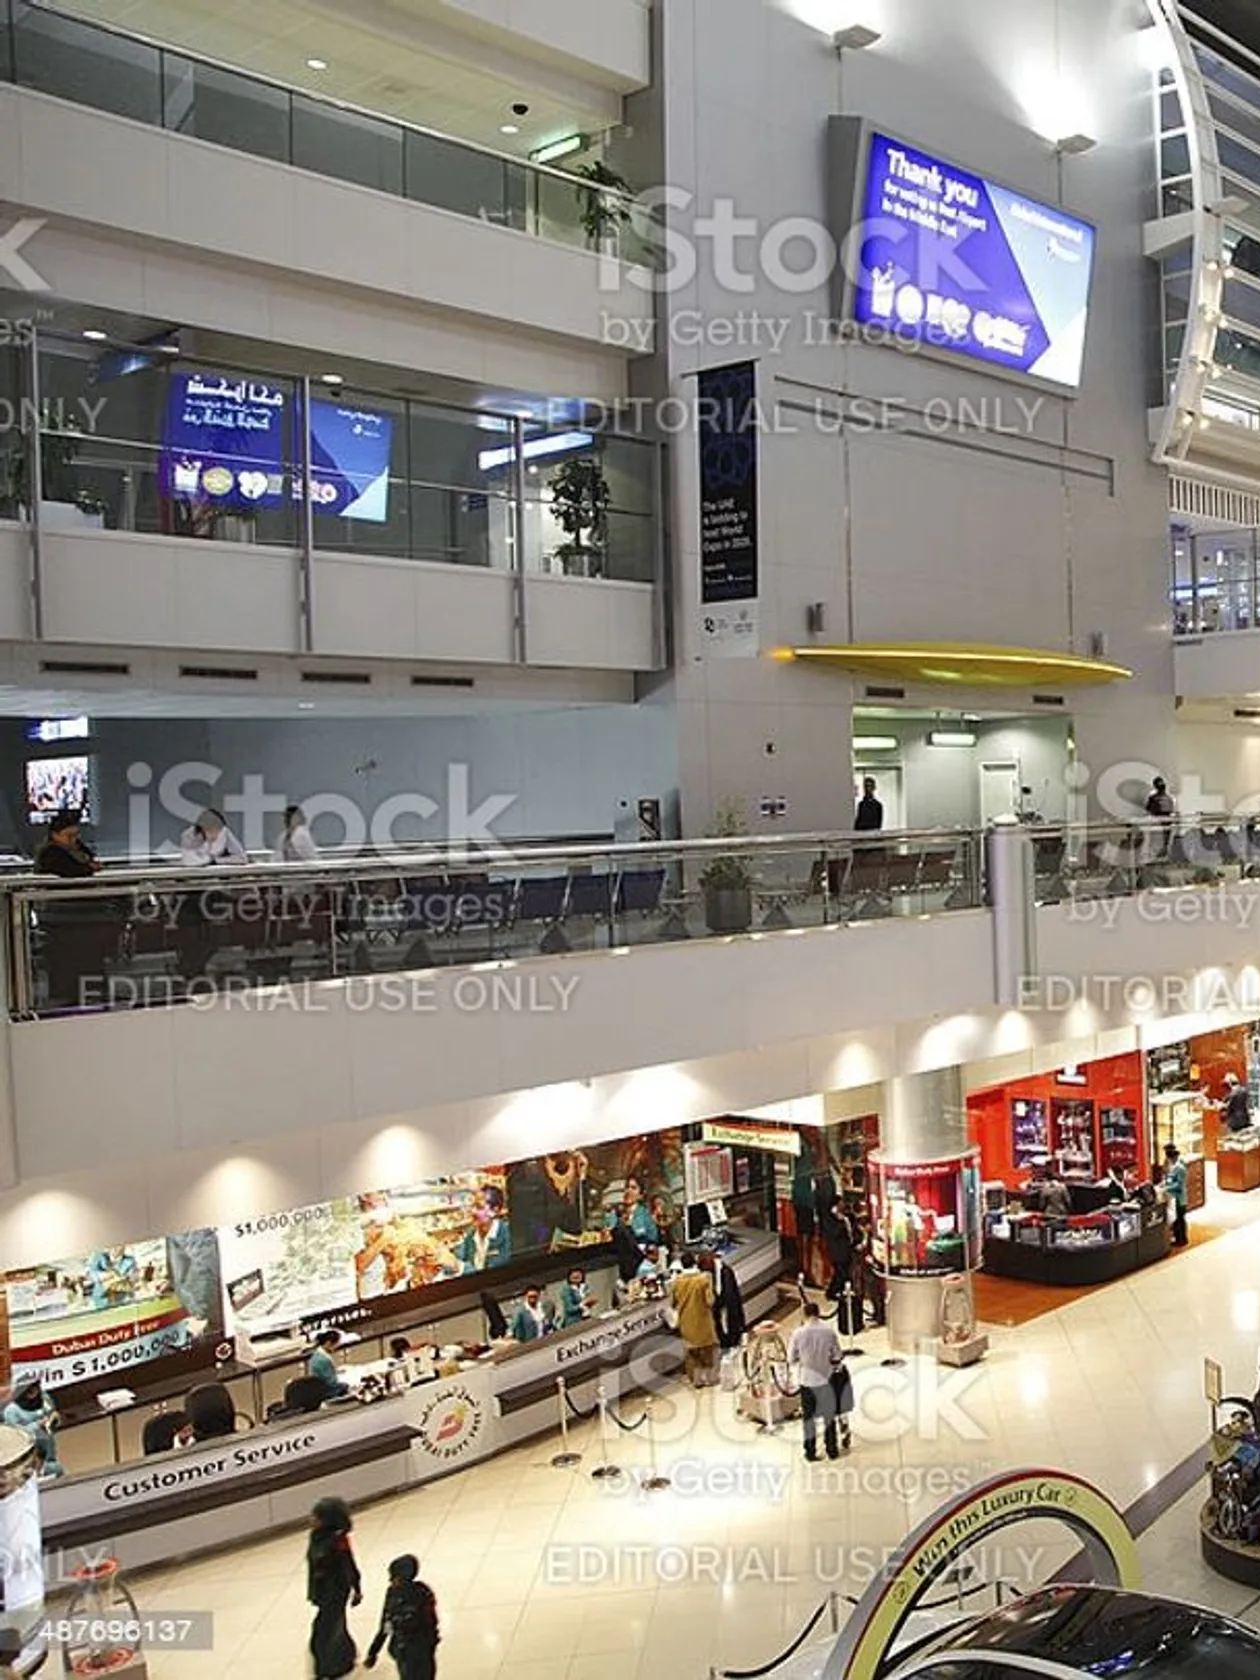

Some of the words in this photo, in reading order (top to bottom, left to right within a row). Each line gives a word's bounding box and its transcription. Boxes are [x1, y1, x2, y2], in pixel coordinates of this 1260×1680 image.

[887, 148, 943, 193] Thank
[943, 178, 979, 208] you
[52, 1339, 97, 1356] Dubai
[556, 1328, 622, 1363] Exchange
[103, 1457, 227, 1500] Customer
[233, 1433, 316, 1467] Service
[913, 1536, 949, 1578] Win
[948, 1510, 981, 1540] this
[981, 1487, 1034, 1516] Luxury
[1035, 1482, 1062, 1502] Car
